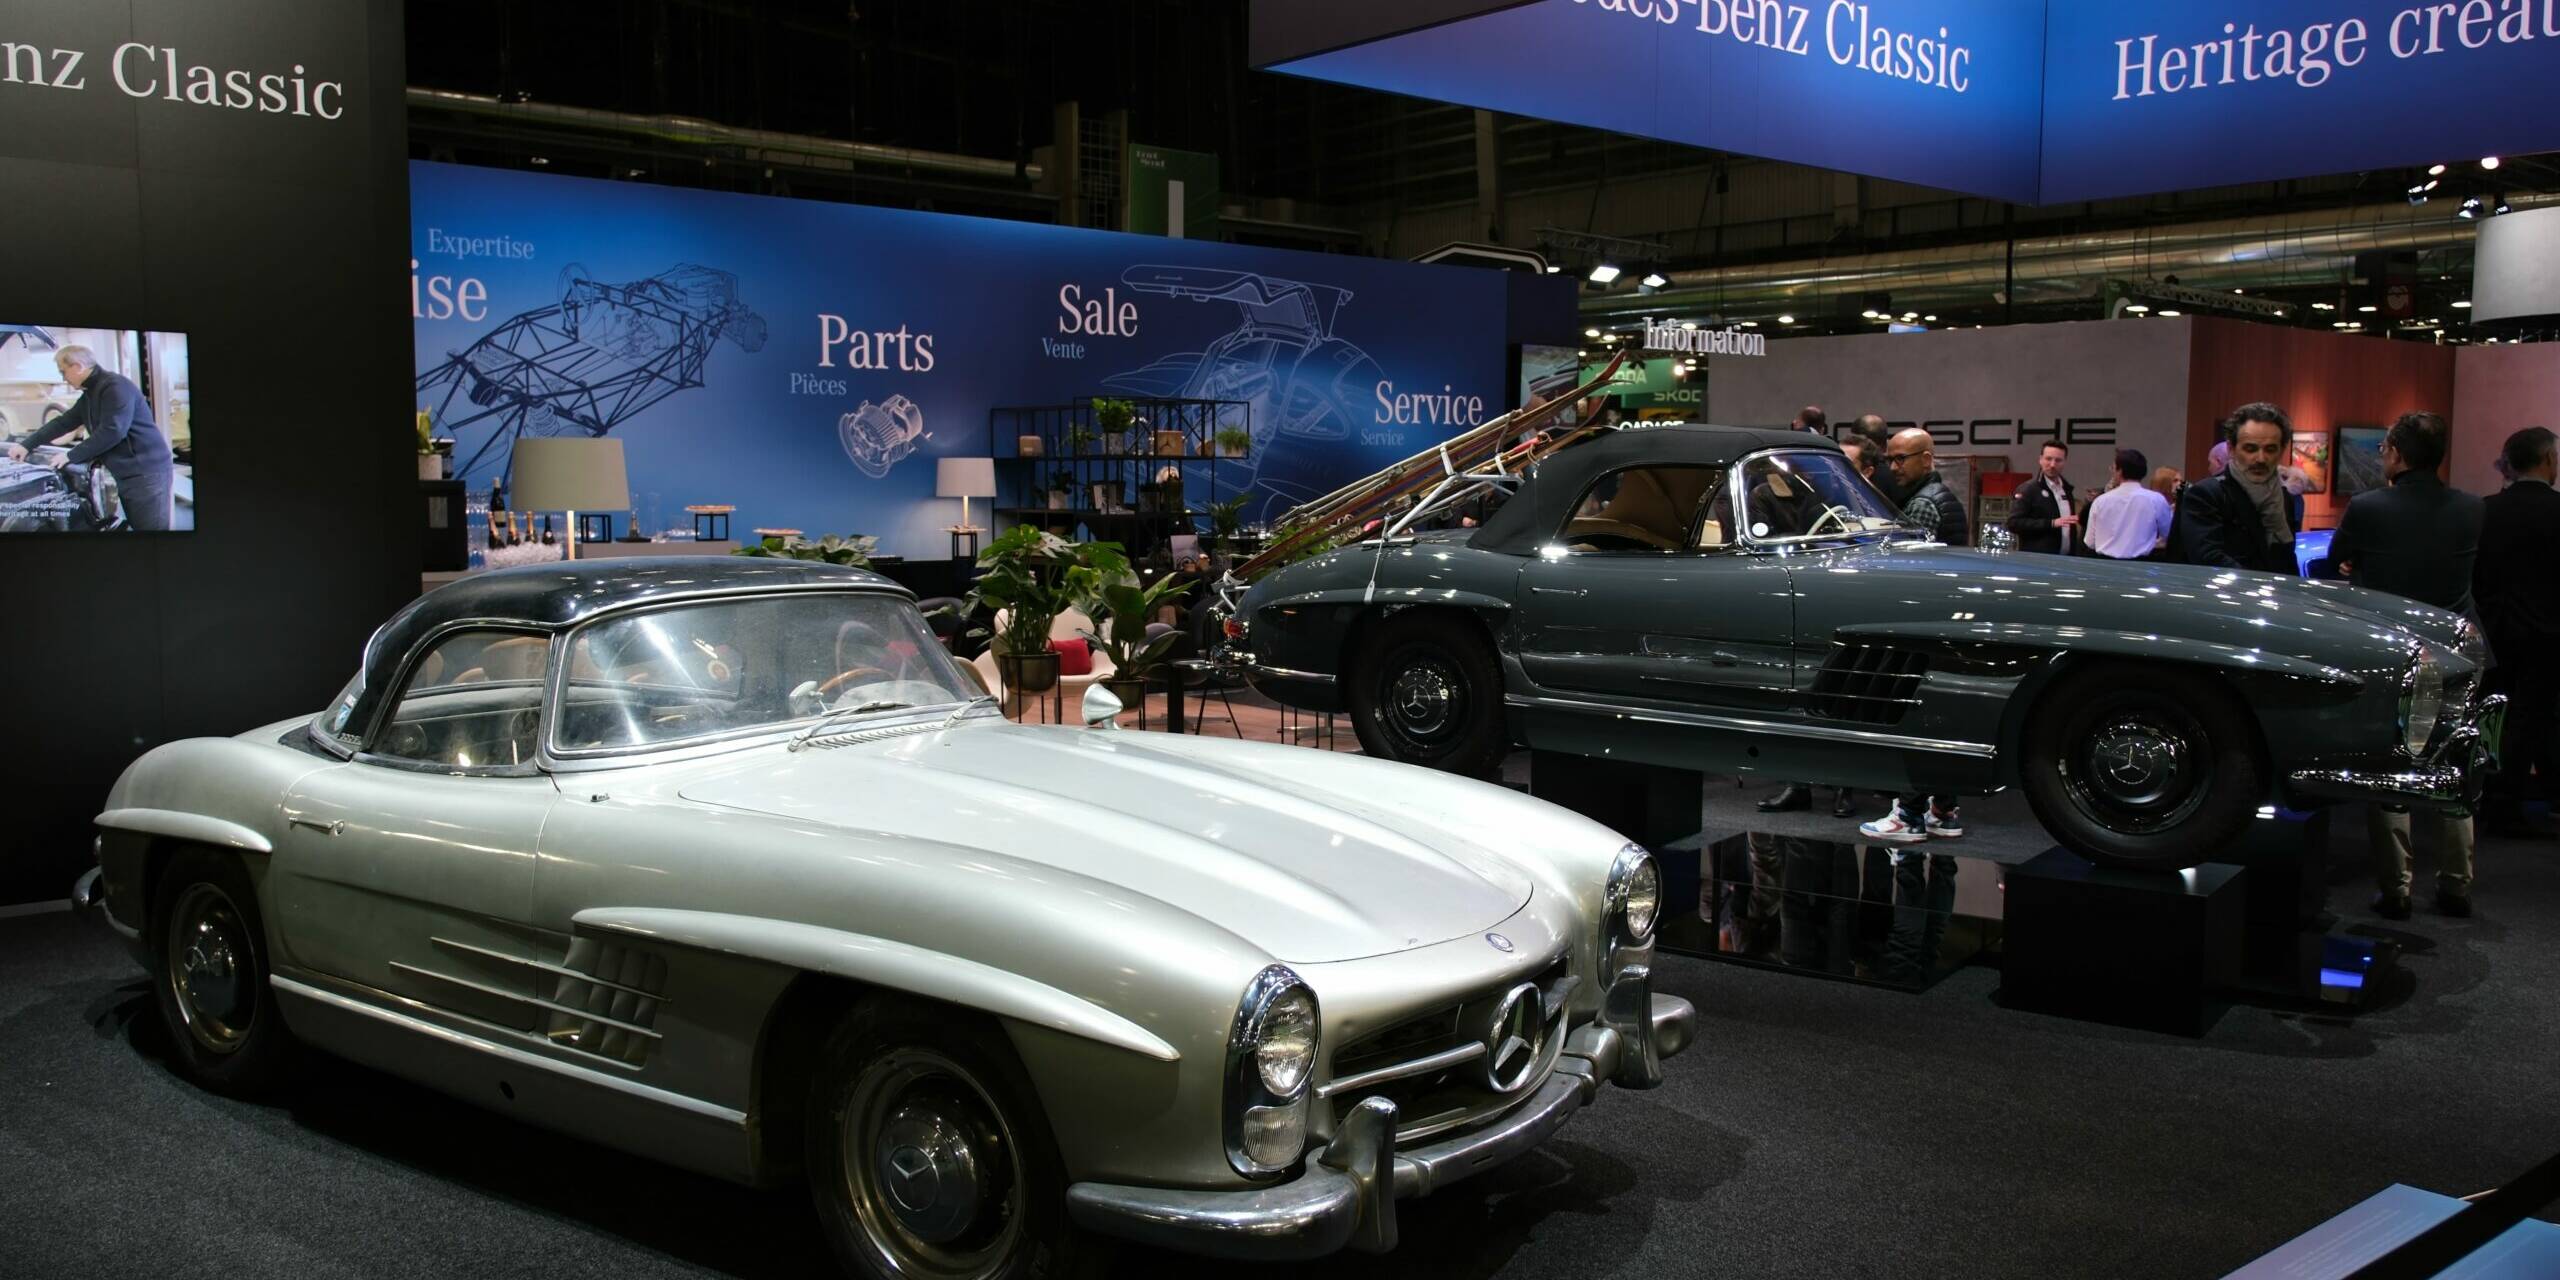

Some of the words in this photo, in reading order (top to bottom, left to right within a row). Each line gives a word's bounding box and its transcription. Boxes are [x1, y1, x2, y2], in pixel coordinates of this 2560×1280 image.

[1825, 0, 1970, 93] Classic
[2111, 17, 2368, 100] Heritage
[112, 41, 345, 121] Classic
[428, 227, 535, 260] Expertise
[411, 258, 488, 323] ise
[1059, 284, 1138, 338] Sale
[817, 314, 935, 373] Parts
[1042, 336, 1085, 361] Vente
[1642, 315, 1766, 357] Information
[790, 371, 848, 397] Pièces
[1374, 381, 1484, 426] Service
[1360, 428, 1405, 447] Service
